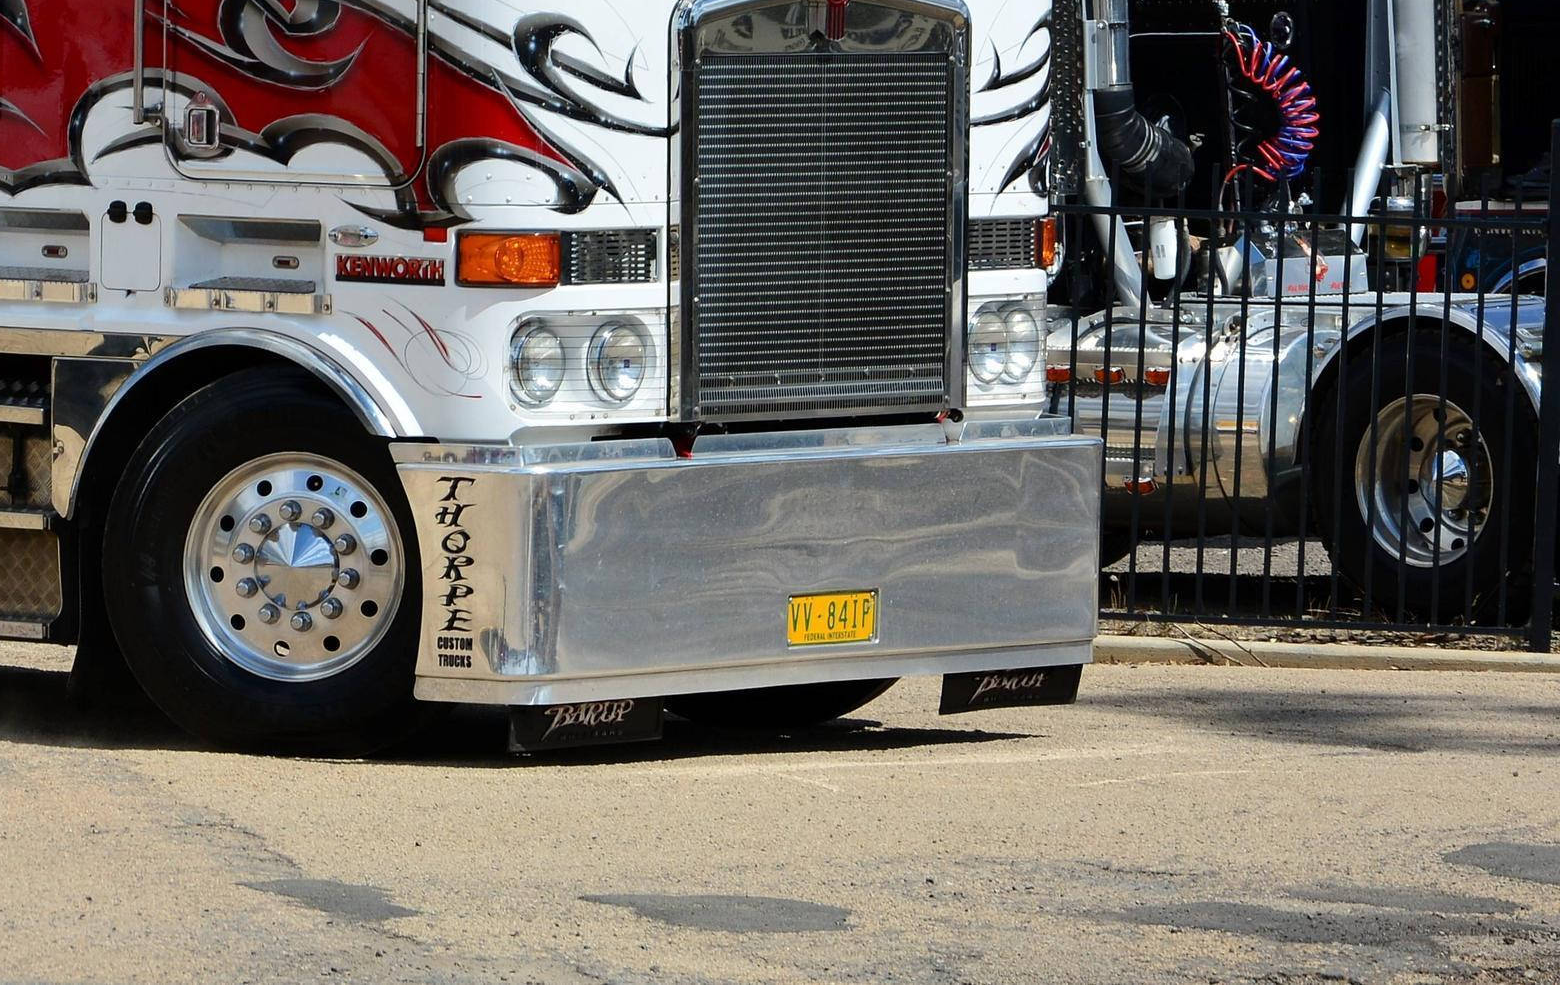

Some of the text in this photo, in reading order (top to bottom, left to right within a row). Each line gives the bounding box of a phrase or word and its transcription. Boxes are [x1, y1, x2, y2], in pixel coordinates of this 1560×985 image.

[336, 256, 445, 280] KENWORTH
[435, 476, 477, 632] THORPE
[804, 630, 856, 641] FEDERAL INTERSTATE
[437, 636, 473, 651] CUSTOM
[438, 653, 472, 668] TRUCKS
